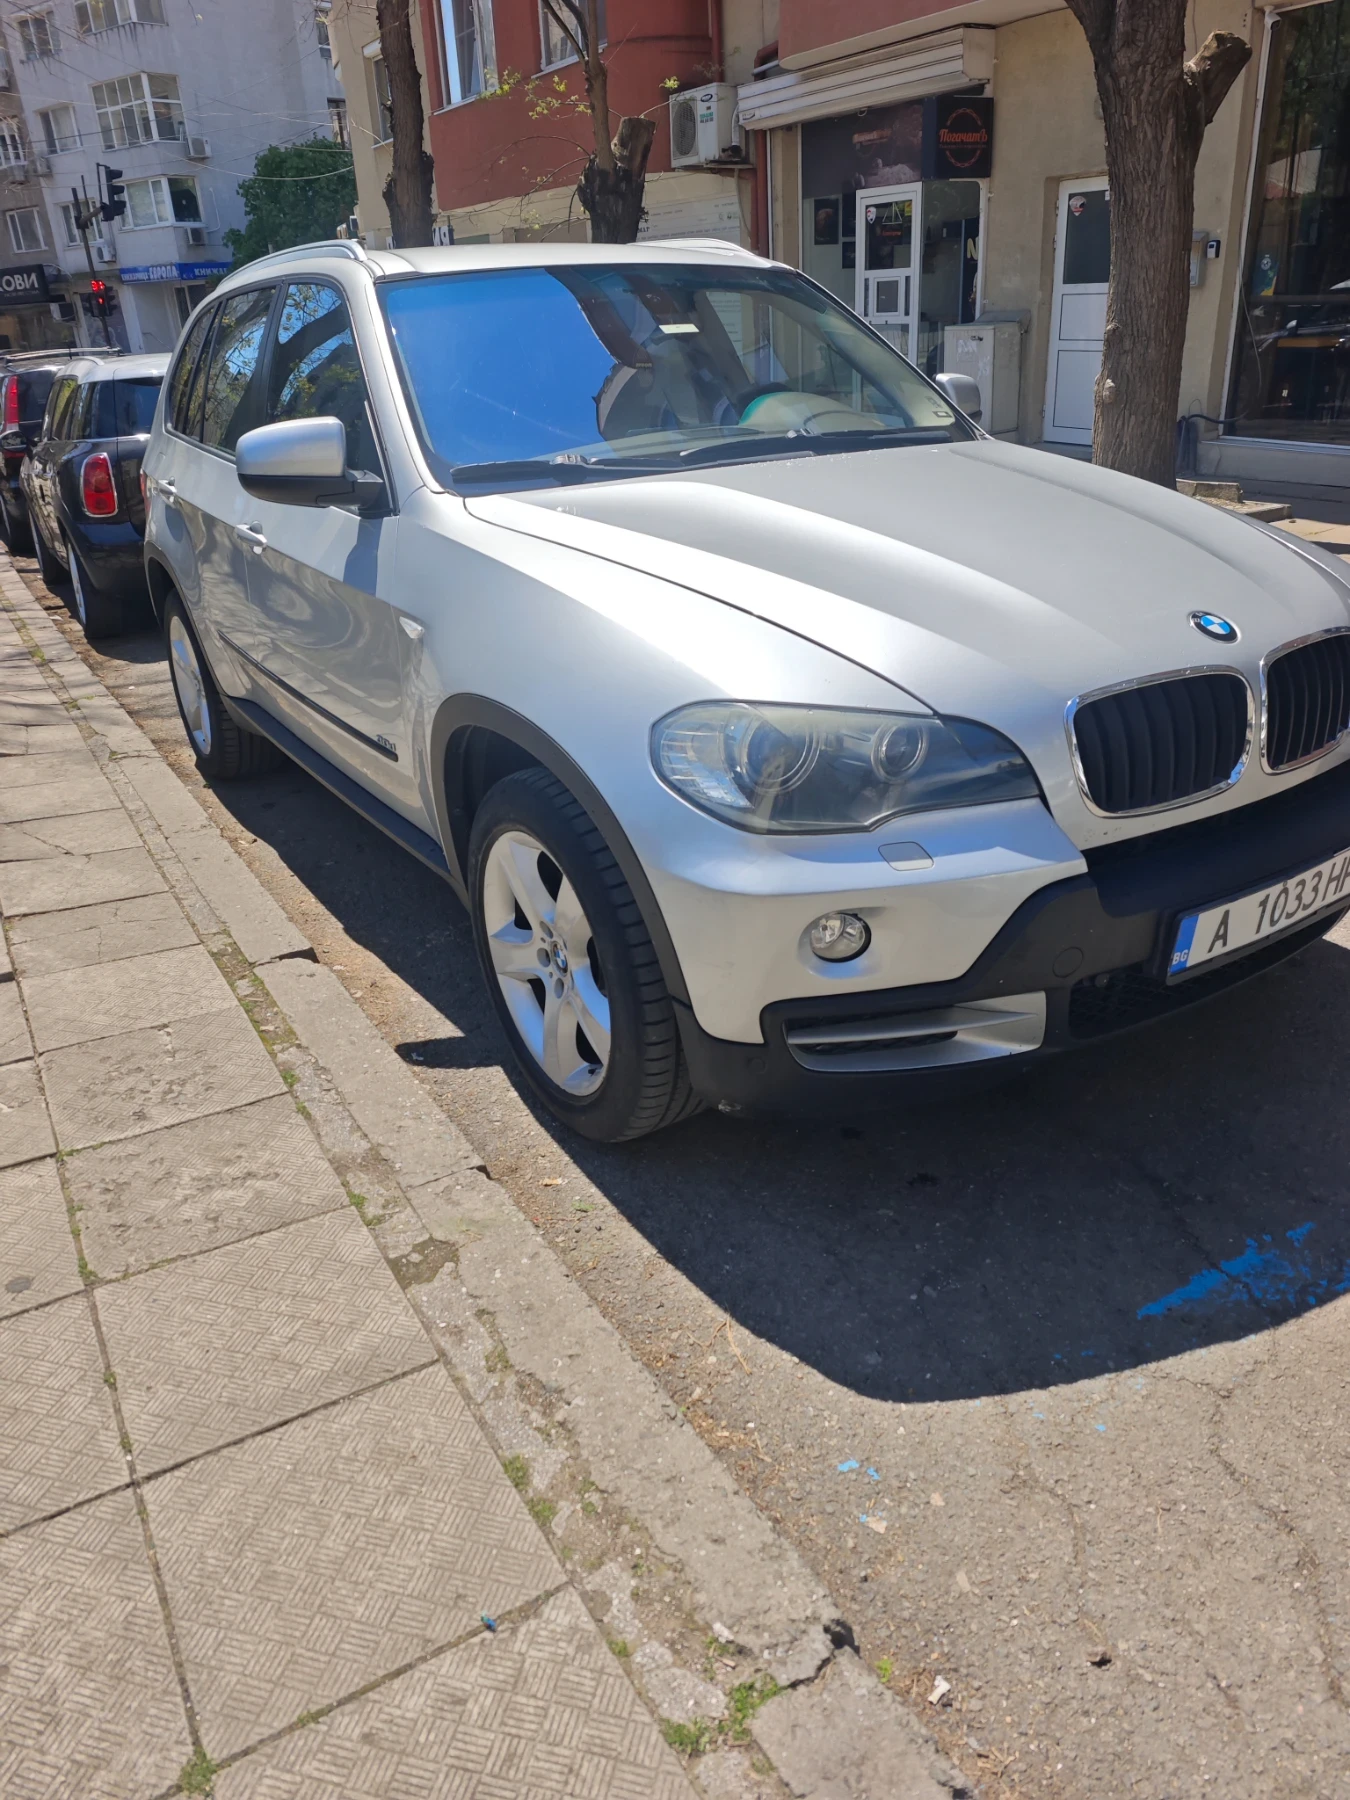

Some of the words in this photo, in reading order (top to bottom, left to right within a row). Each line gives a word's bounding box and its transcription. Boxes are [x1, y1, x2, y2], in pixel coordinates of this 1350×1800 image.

[0, 272, 38, 291] ОВИ
[1207, 909, 1230, 953] A
[1256, 871, 1322, 934] 1033
[1172, 949, 1188, 964] BG
